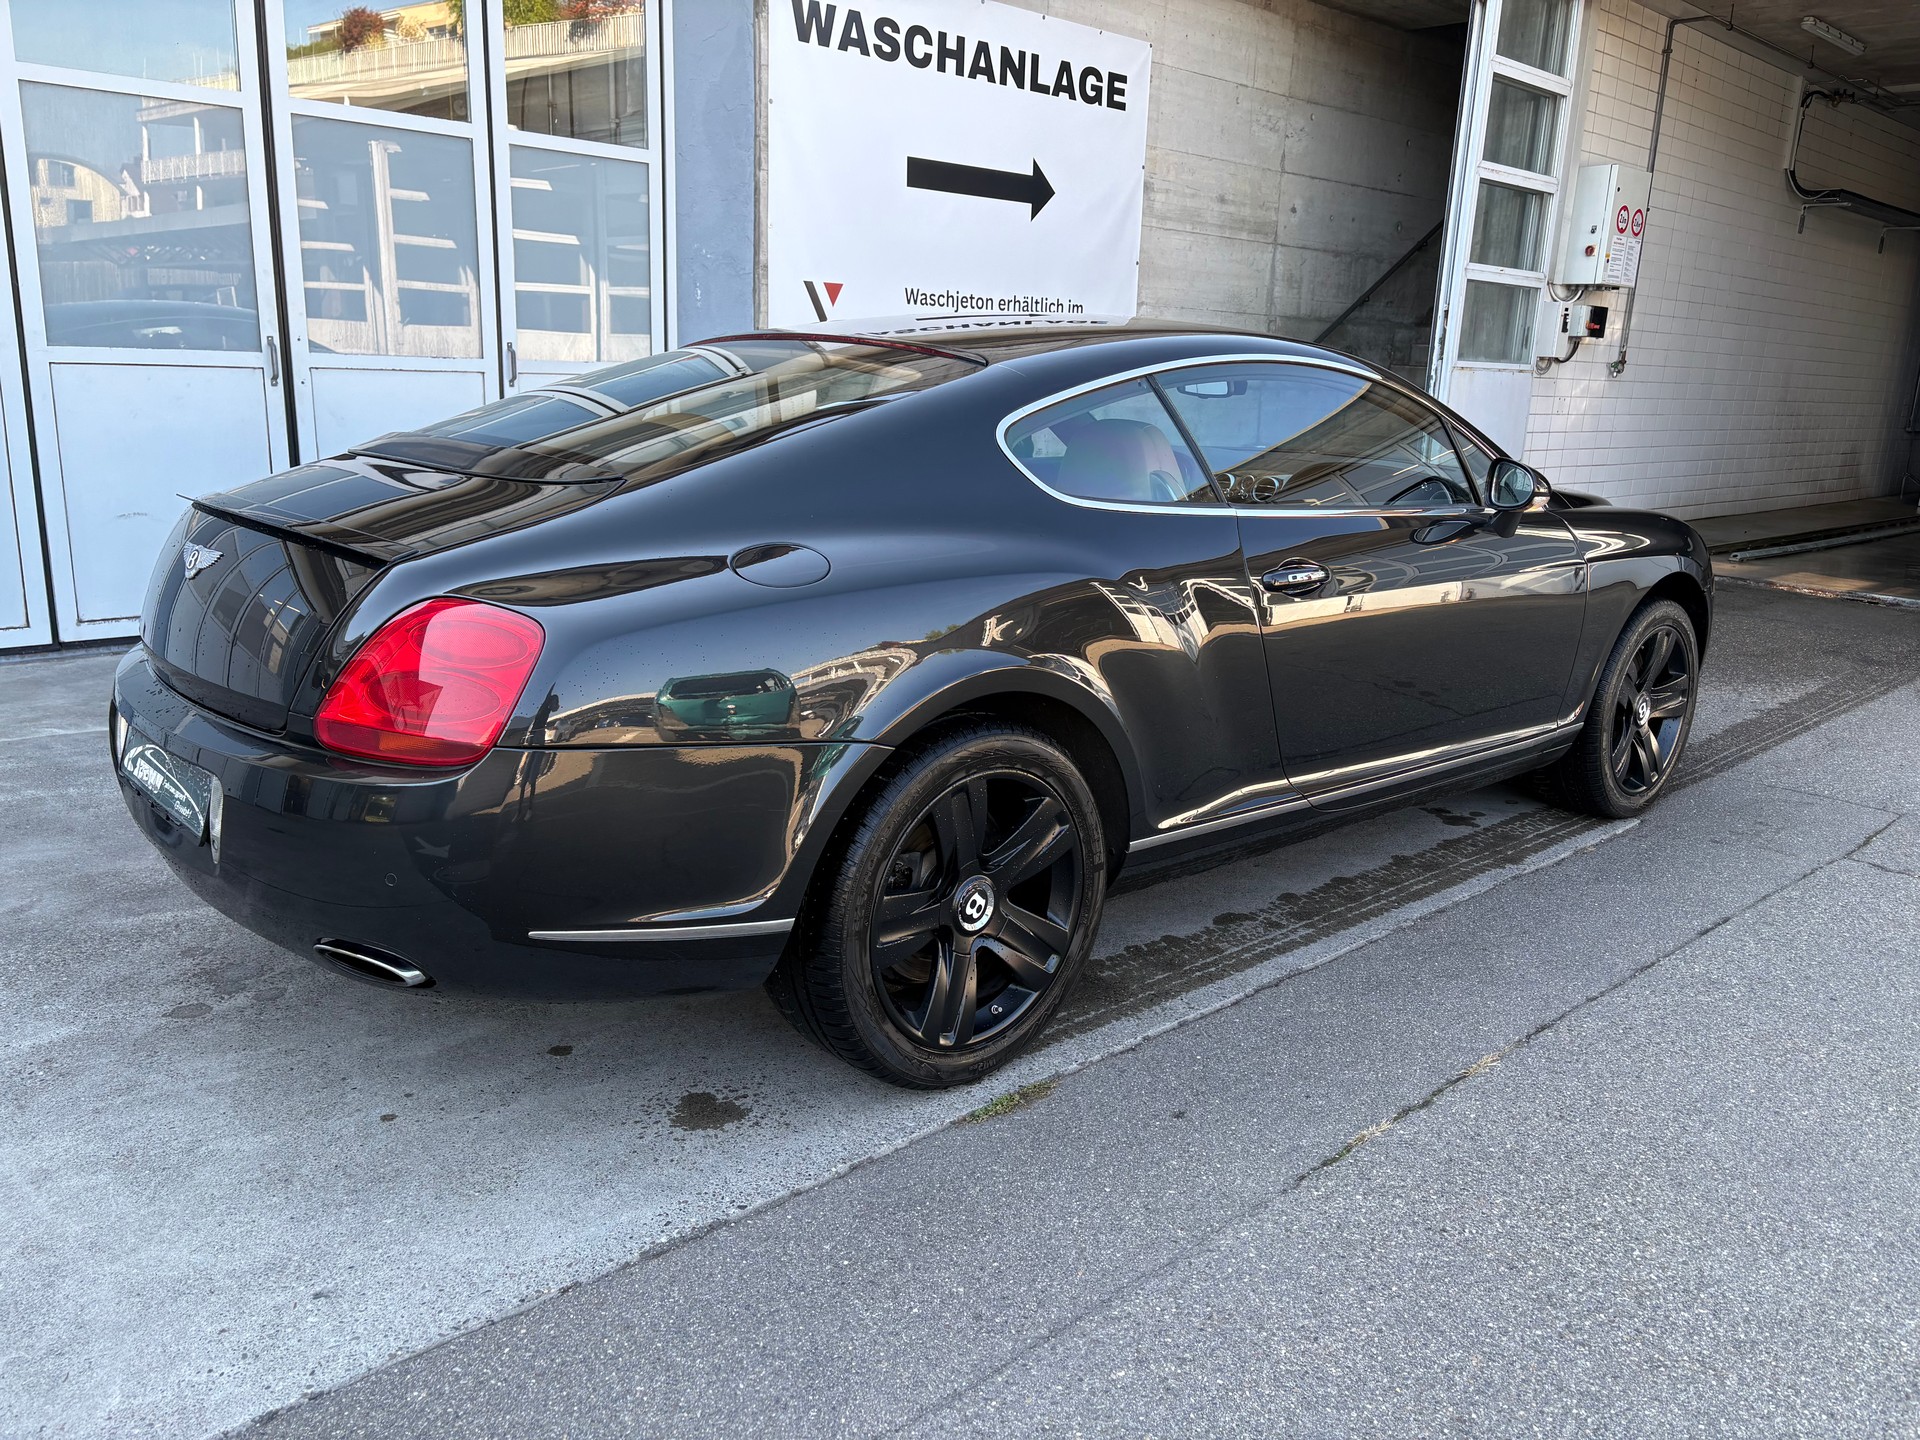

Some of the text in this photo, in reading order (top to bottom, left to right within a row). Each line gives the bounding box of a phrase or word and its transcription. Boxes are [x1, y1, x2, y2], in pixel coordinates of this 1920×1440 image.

[791, 0, 1128, 111] WASCHANLAGE
[905, 287, 1084, 314] Waschjeton erhältlich im
